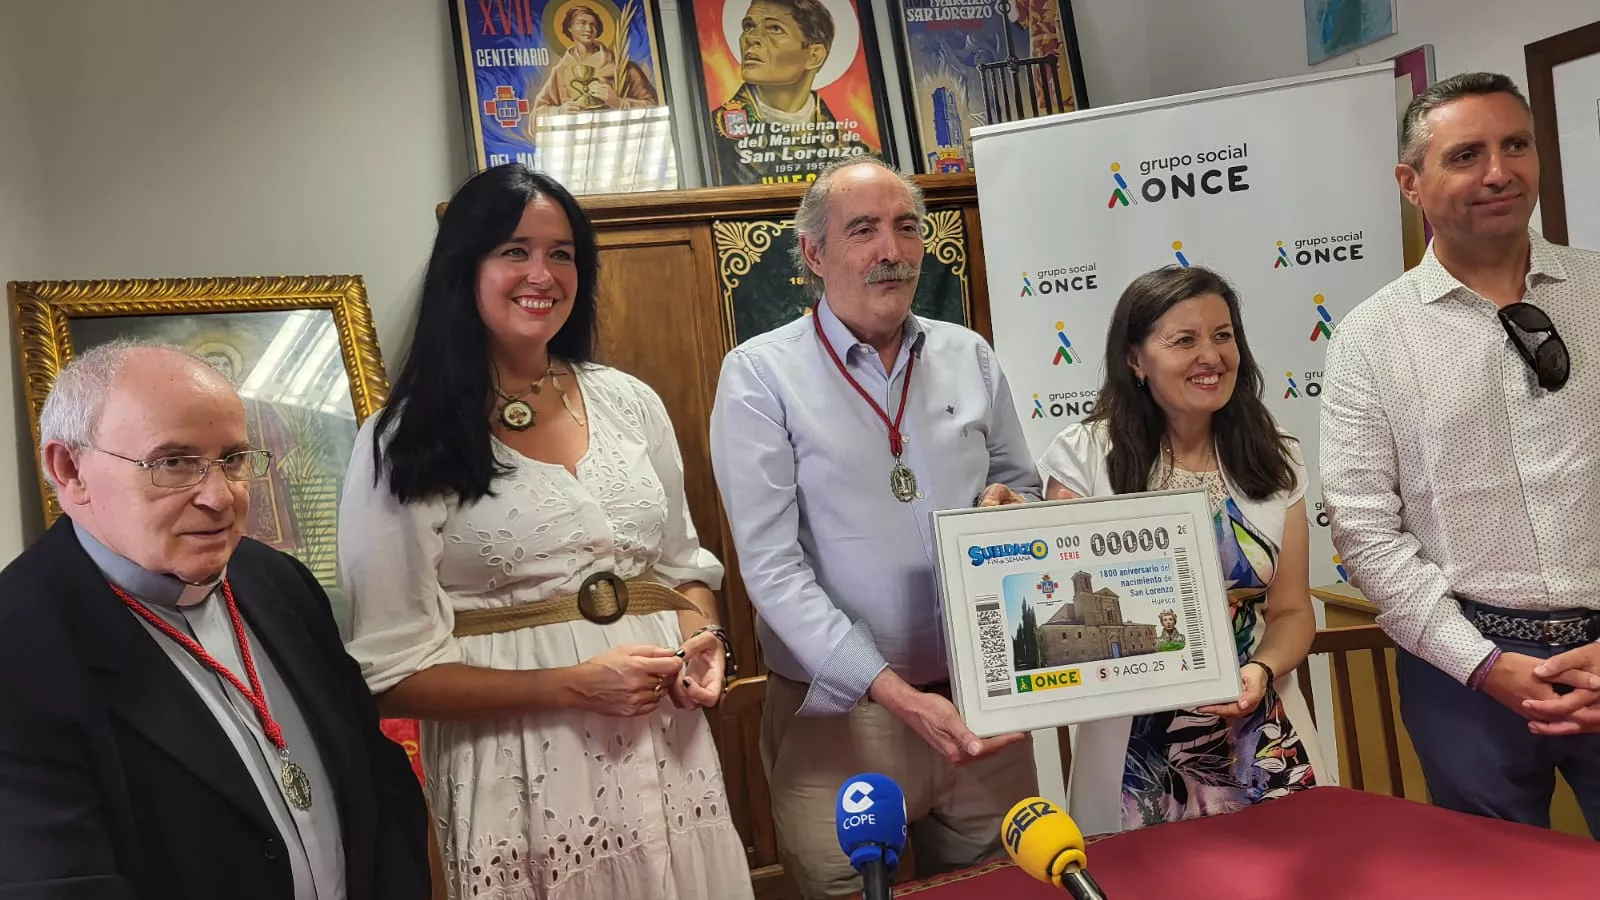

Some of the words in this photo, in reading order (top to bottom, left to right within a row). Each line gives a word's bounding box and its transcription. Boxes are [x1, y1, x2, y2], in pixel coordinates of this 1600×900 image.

[479, 0, 534, 36] XVII
[476, 48, 550, 67] CENTENARIO
[734, 122, 764, 136] XVII
[770, 118, 858, 134] Centenario
[737, 136, 762, 149] del
[769, 131, 835, 147] Martirio
[842, 130, 860, 142] de
[740, 149, 776, 164] San
[781, 145, 864, 161] Lorenzo
[1140, 154, 1192, 175] grupo
[1197, 143, 1247, 164] social
[775, 164, 801, 173] 1957
[1142, 165, 1250, 203] ONCE
[1294, 236, 1328, 250] grupo
[1330, 230, 1363, 243] social
[1296, 244, 1364, 266] ONCE
[1037, 268, 1067, 280] grupo
[1068, 261, 1096, 273] social
[1039, 275, 1098, 295] ONCE
[1049, 391, 1078, 402] grupo
[1050, 400, 1096, 417] ONC
[1055, 535, 1081, 549] 000
[1090, 526, 1170, 557] 00000
[1177, 525, 1188, 535] 2€
[1059, 551, 1081, 561] SERIE
[1099, 568, 1118, 578] 1800
[1119, 564, 1159, 577] aniversario
[1160, 563, 1171, 572] del
[1120, 576, 1163, 588] nacimiento
[1163, 575, 1173, 583] de
[1129, 588, 1144, 598] San
[1145, 584, 1174, 596] Lorenzo
[1113, 666, 1120, 677] 9
[1153, 660, 1166, 672] 25
[1034, 671, 1078, 688] ONCE
[843, 813, 876, 830] COPE
[1005, 801, 1058, 854] SER
